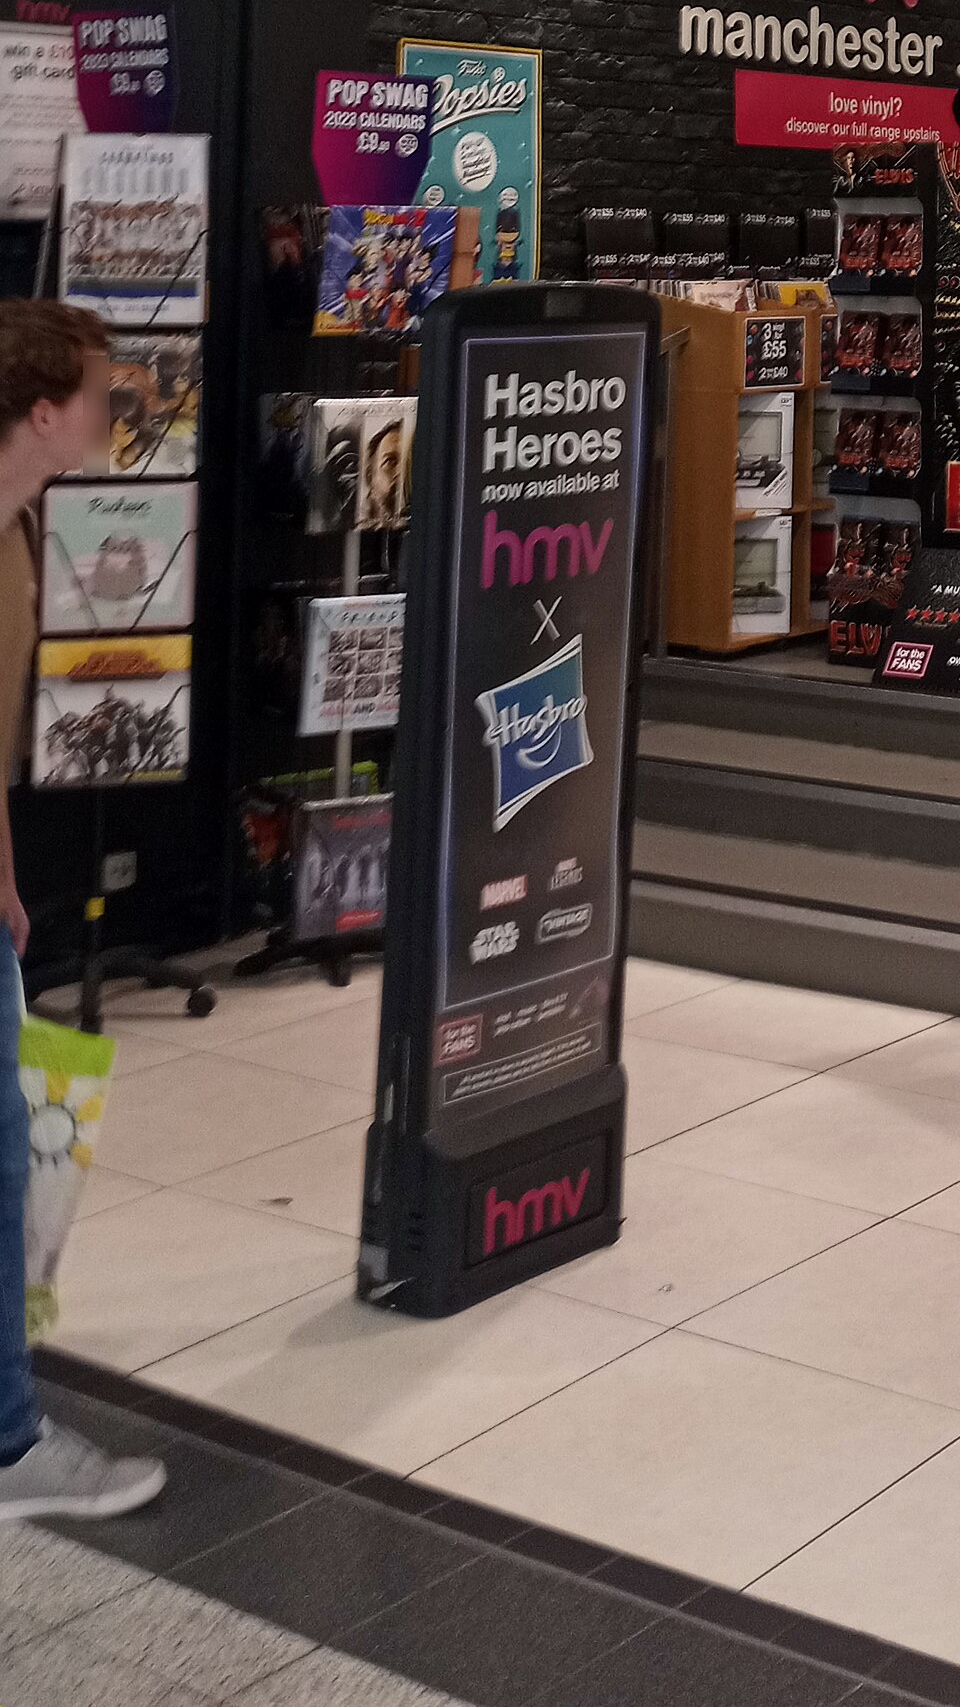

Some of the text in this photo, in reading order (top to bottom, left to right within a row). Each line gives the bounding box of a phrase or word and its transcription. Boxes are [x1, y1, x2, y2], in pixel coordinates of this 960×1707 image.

[79, 13, 168, 47] POP SWAG
[679, 5, 943, 76] manchester
[326, 80, 428, 110] POP SWAG
[829, 91, 903, 118] love vinyl?
[322, 111, 426, 131] 2023 CALENDARS
[786, 117, 940, 141] discover our full range upstairs
[875, 168, 915, 184] ELVIS
[762, 322, 772, 341] 3
[762, 340, 787, 360] £55
[484, 370, 626, 419] Hasbro
[482, 426, 622, 473] Heroes
[480, 469, 620, 504] now available at
[480, 510, 615, 589] hmv
[890, 657, 923, 671] FANS
[896, 647, 925, 659] for the
[483, 695, 588, 747] Hasbro
[471, 921, 520, 948] STAR
[441, 1036, 475, 1058] FANS
[483, 1167, 590, 1255] hmv
